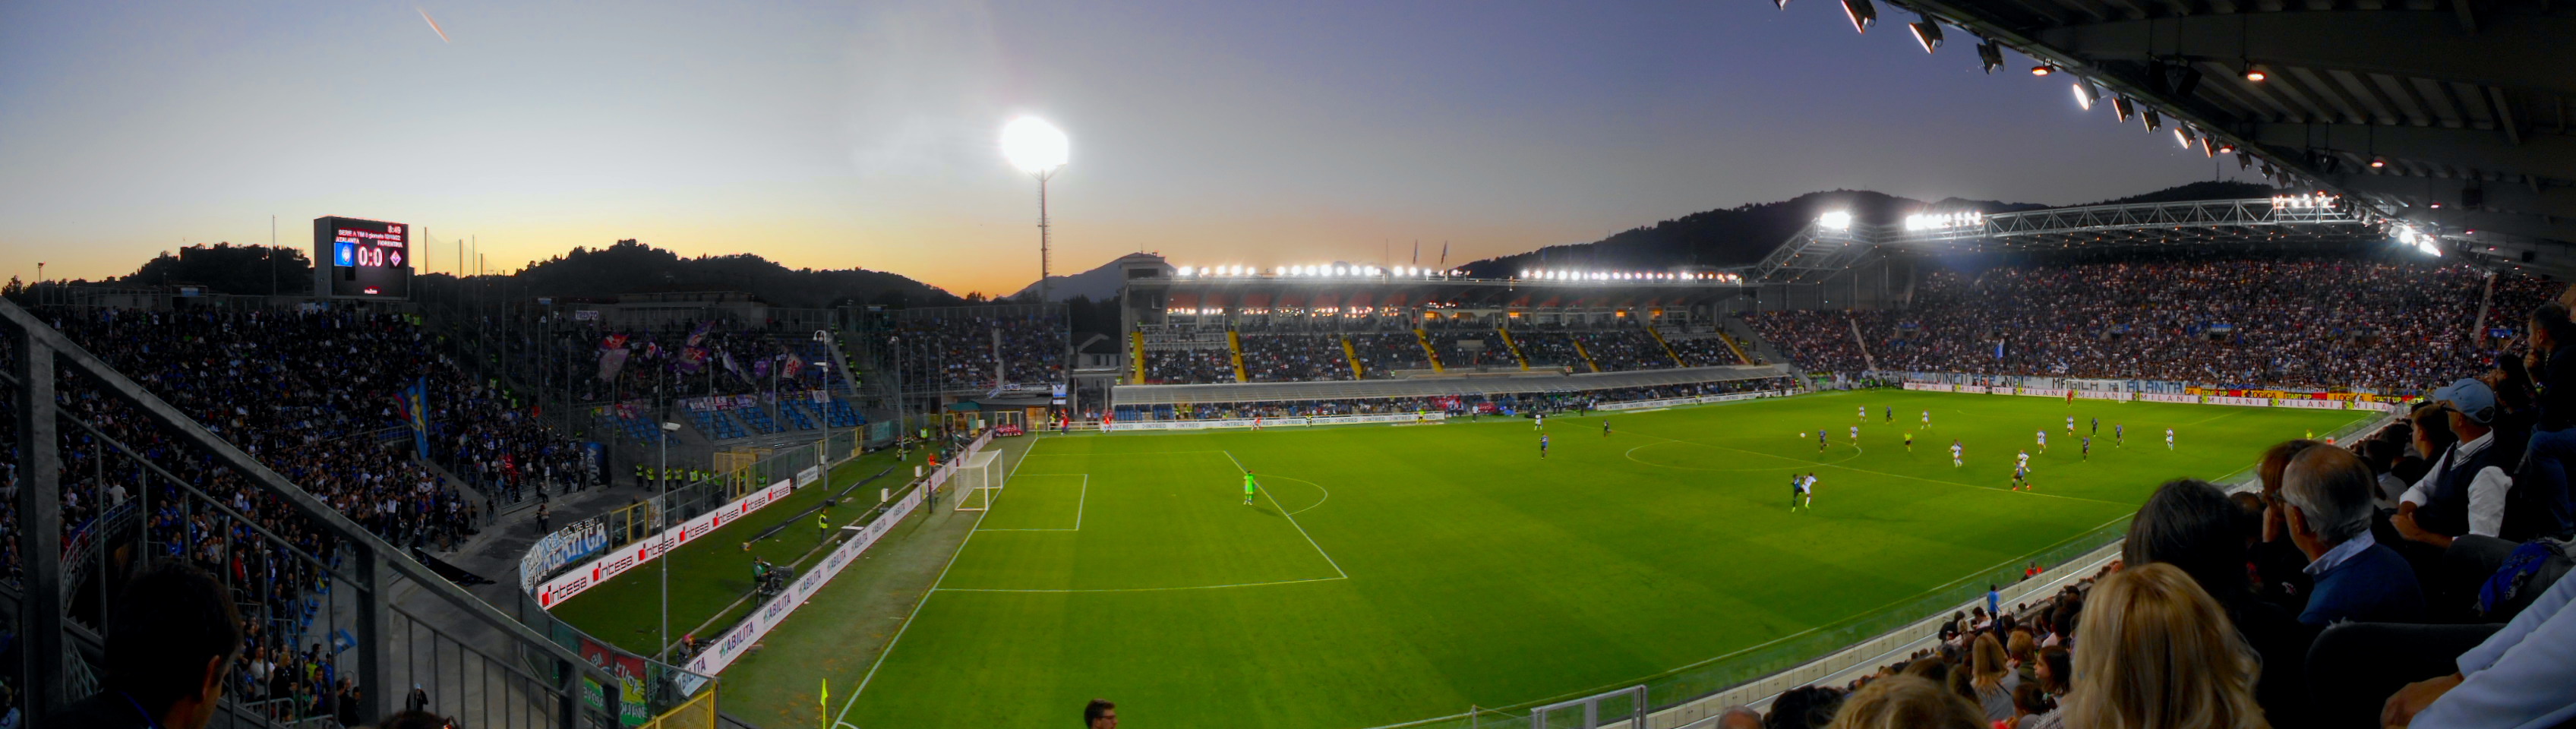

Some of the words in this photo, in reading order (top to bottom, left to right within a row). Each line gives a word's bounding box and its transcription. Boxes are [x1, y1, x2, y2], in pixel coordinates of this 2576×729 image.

[715, 508, 739, 526] intesa
[682, 522, 709, 541] intesa
[598, 555, 633, 581] intesa
[548, 576, 588, 604] intesa
[718, 621, 753, 658] HABILITA
